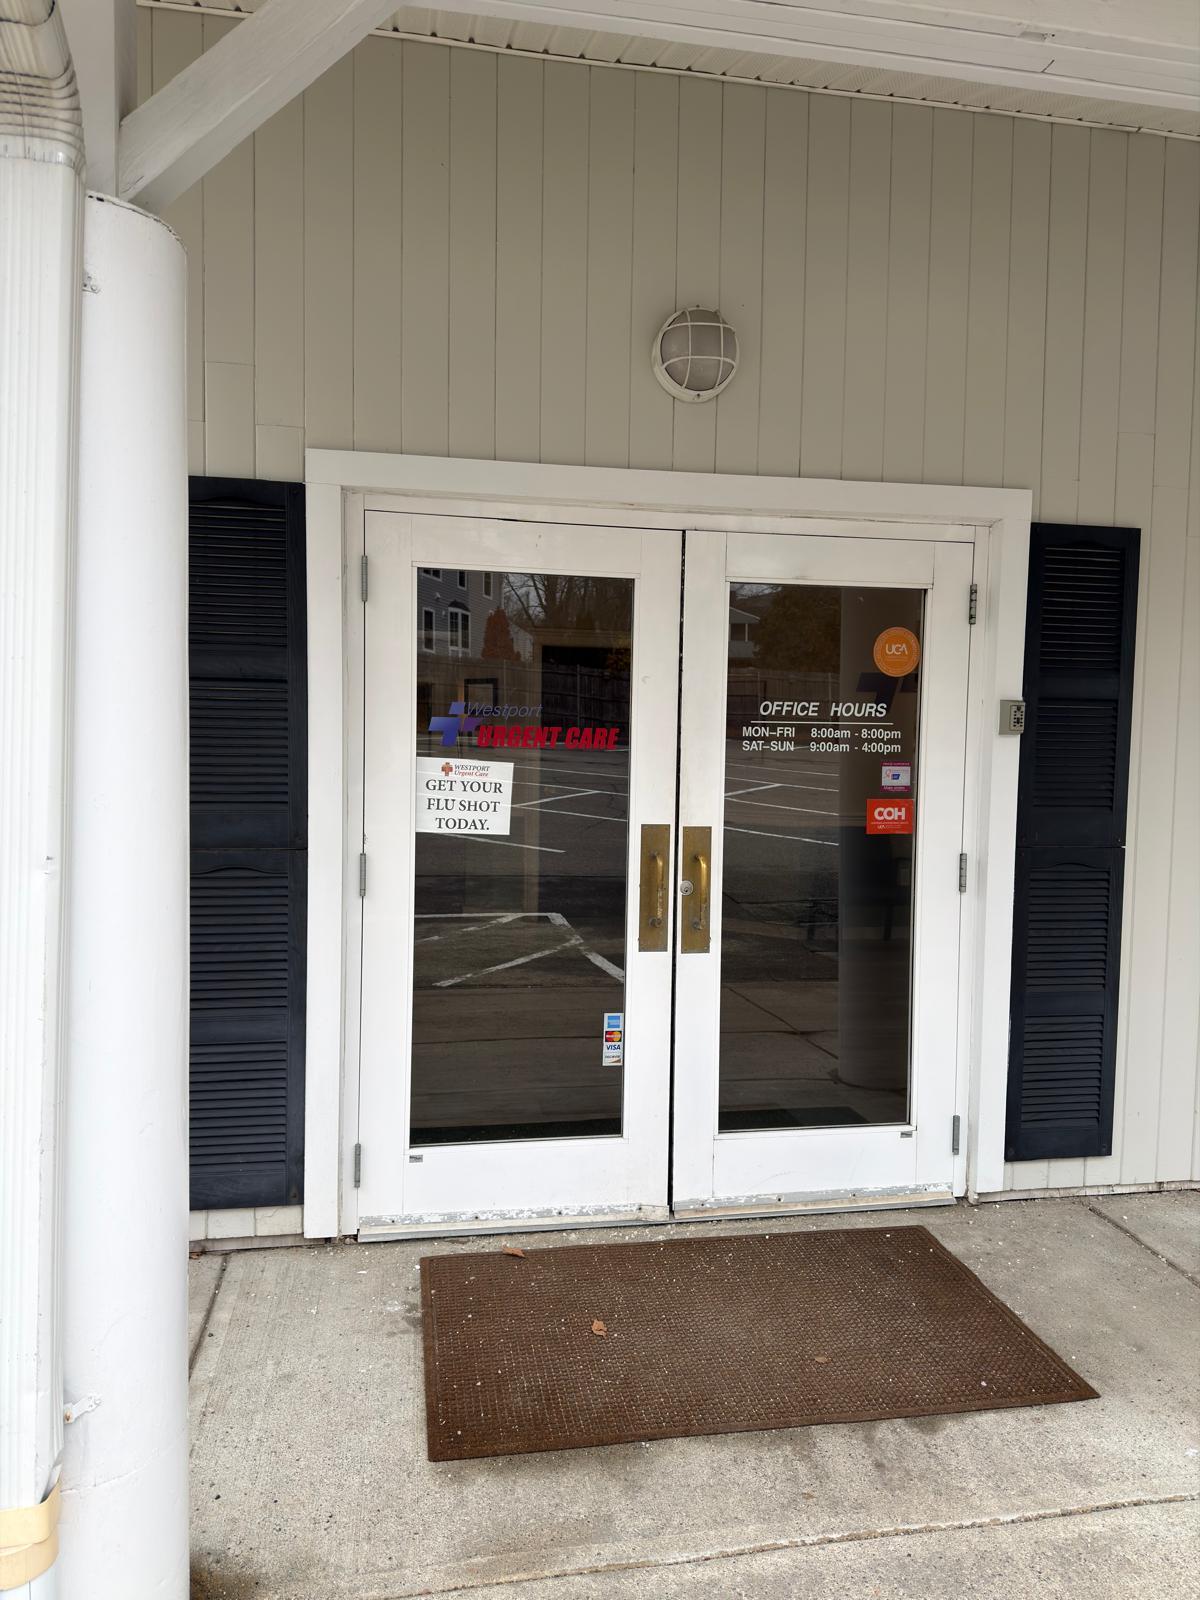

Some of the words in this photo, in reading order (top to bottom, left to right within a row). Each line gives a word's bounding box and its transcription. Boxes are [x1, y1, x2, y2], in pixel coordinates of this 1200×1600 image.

[467, 702, 543, 719] Westport
[759, 701, 819, 716] OFFICE
[830, 703, 887, 717] HOURS
[477, 726, 561, 749] URGENT
[565, 727, 620, 750] CARE
[811, 728, 851, 738] 8:00am
[861, 729, 901, 740] 8:00pm
[809, 742, 850, 752] 9:00am
[861, 743, 901, 755] 4:00pm
[454, 764, 490, 772] WESTPORT
[426, 779, 456, 791] GET
[460, 780, 503, 793] YOUR
[427, 798, 455, 811] FLU
[459, 799, 500, 812] SHOT
[874, 807, 906, 820] COH
[435, 817, 489, 830] TODAY.
